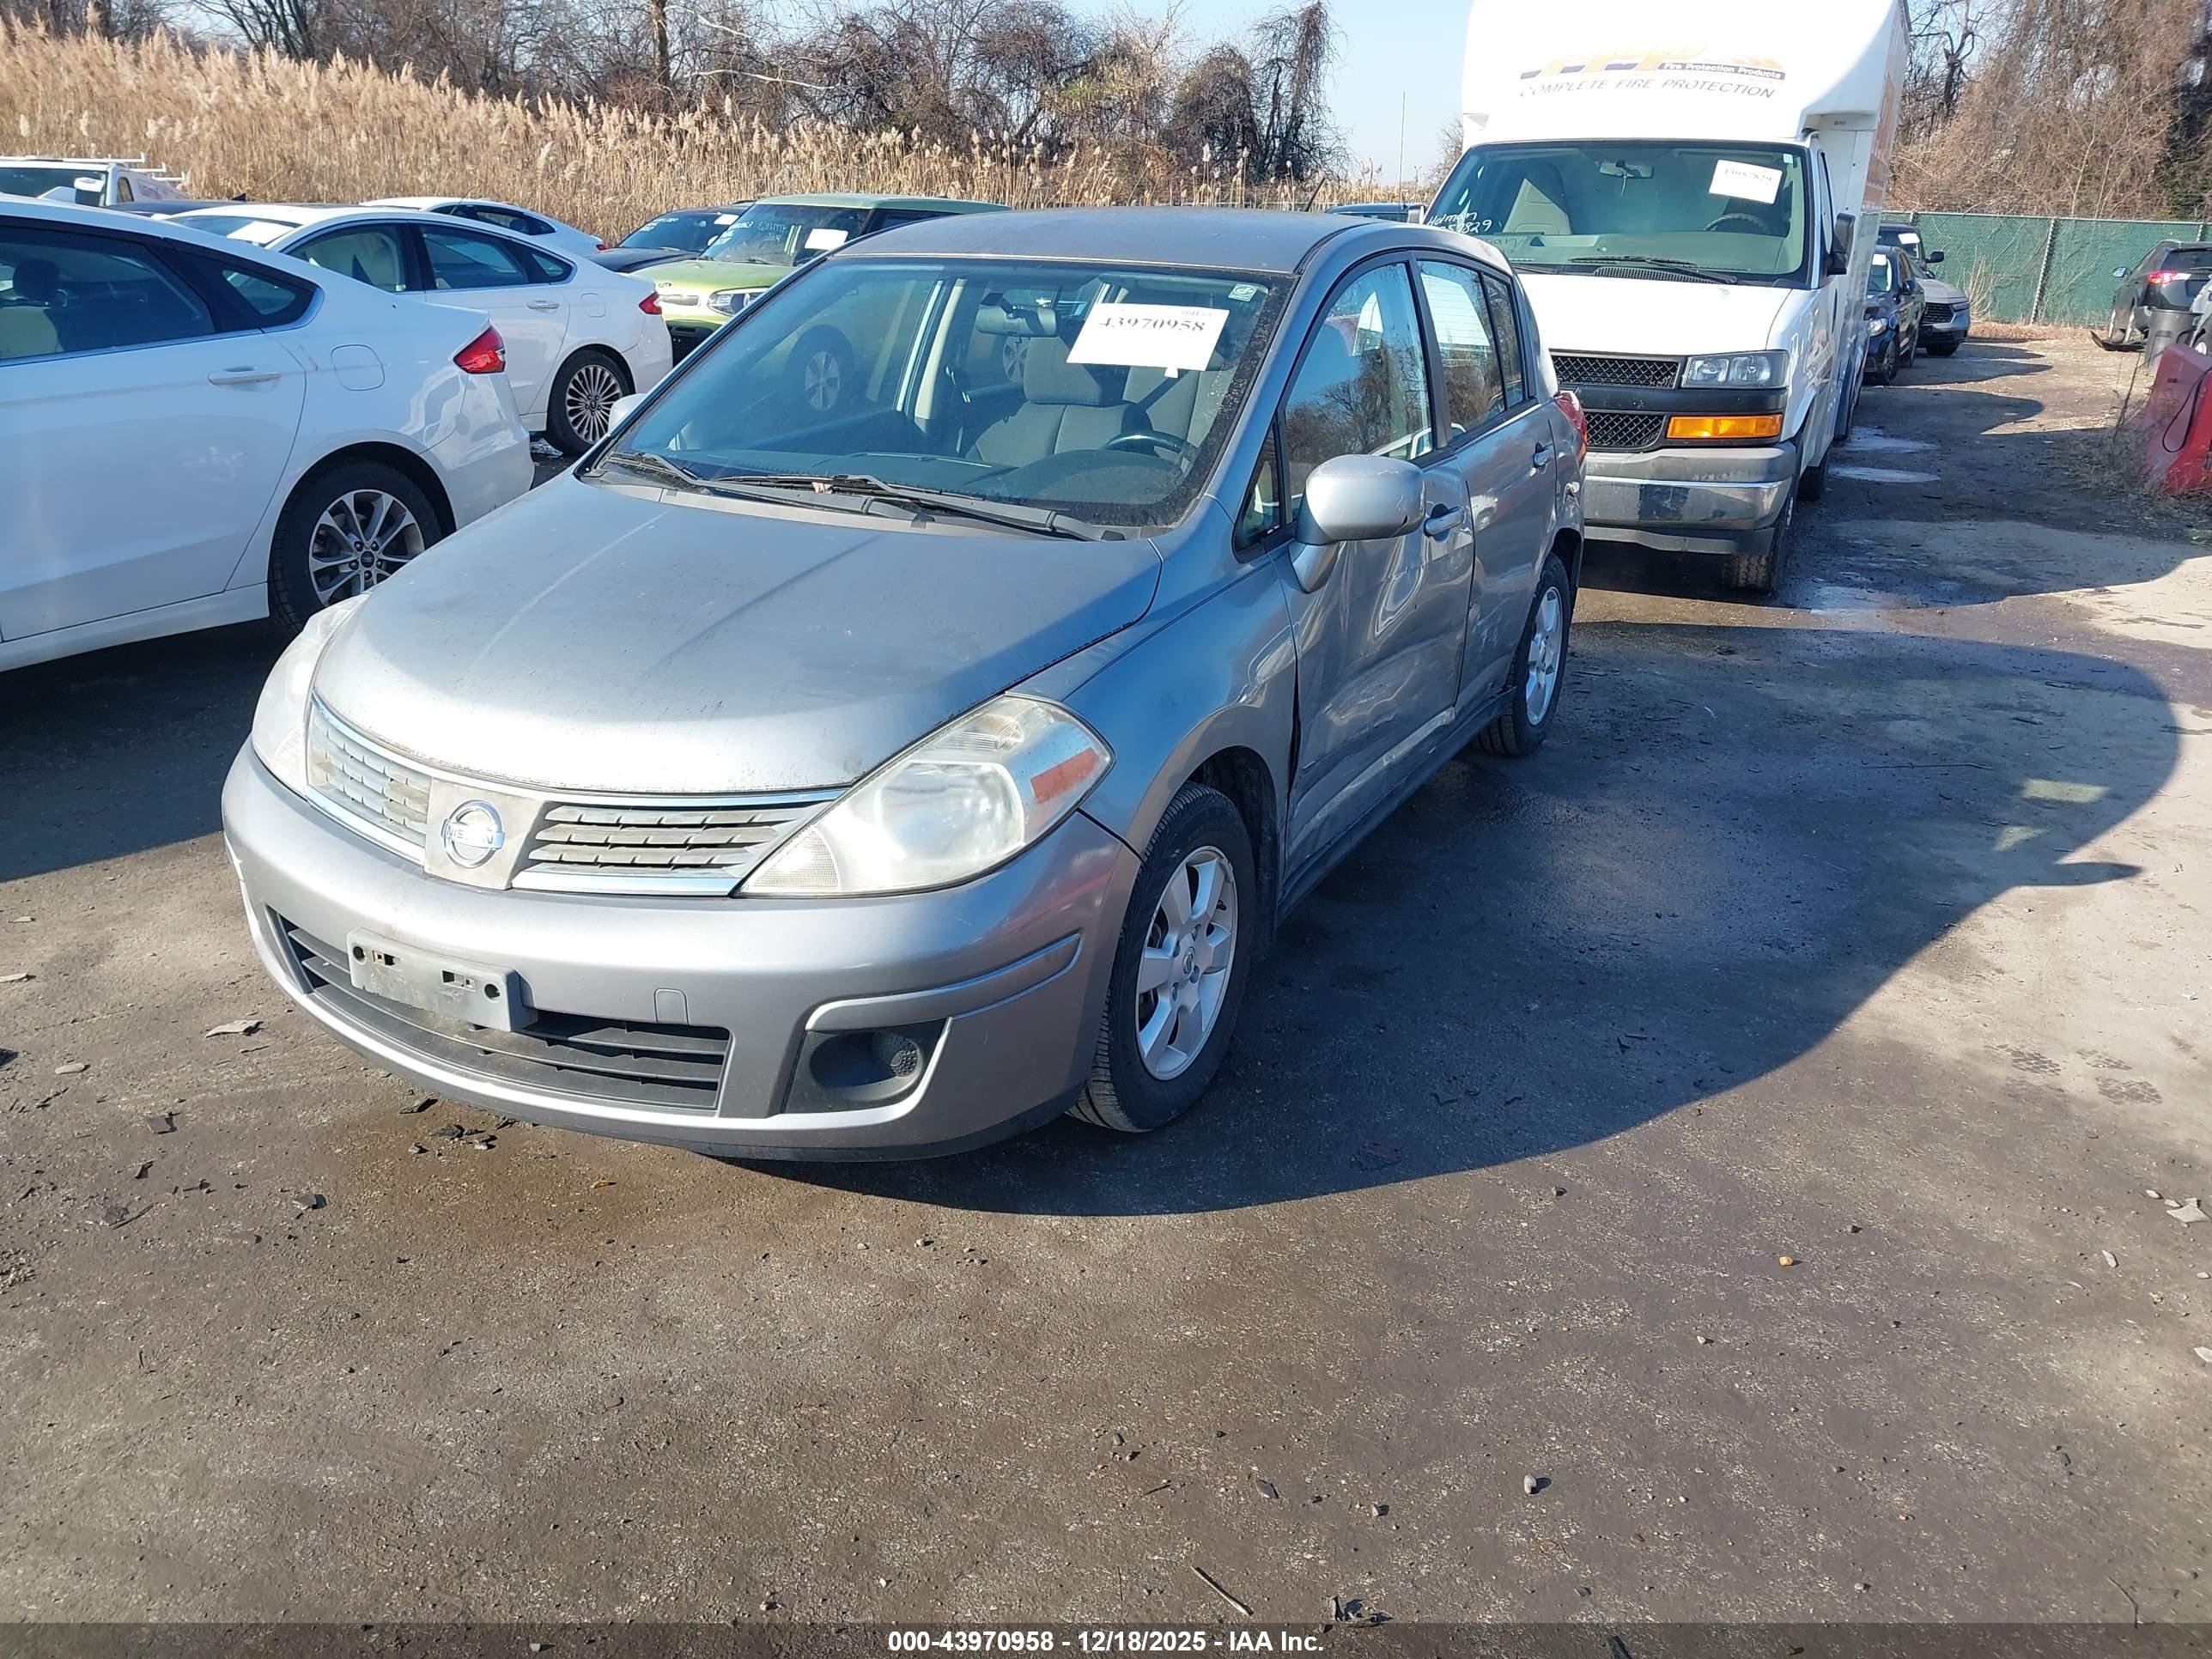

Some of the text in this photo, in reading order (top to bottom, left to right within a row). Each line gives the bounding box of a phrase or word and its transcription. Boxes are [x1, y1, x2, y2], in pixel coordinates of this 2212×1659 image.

[1685, 63, 1735, 74] Protection
[1737, 66, 1782, 79] Products
[1520, 79, 1775, 99] COMPLETE FIRE PROTECTION
[1100, 317, 1206, 331] 43970958
